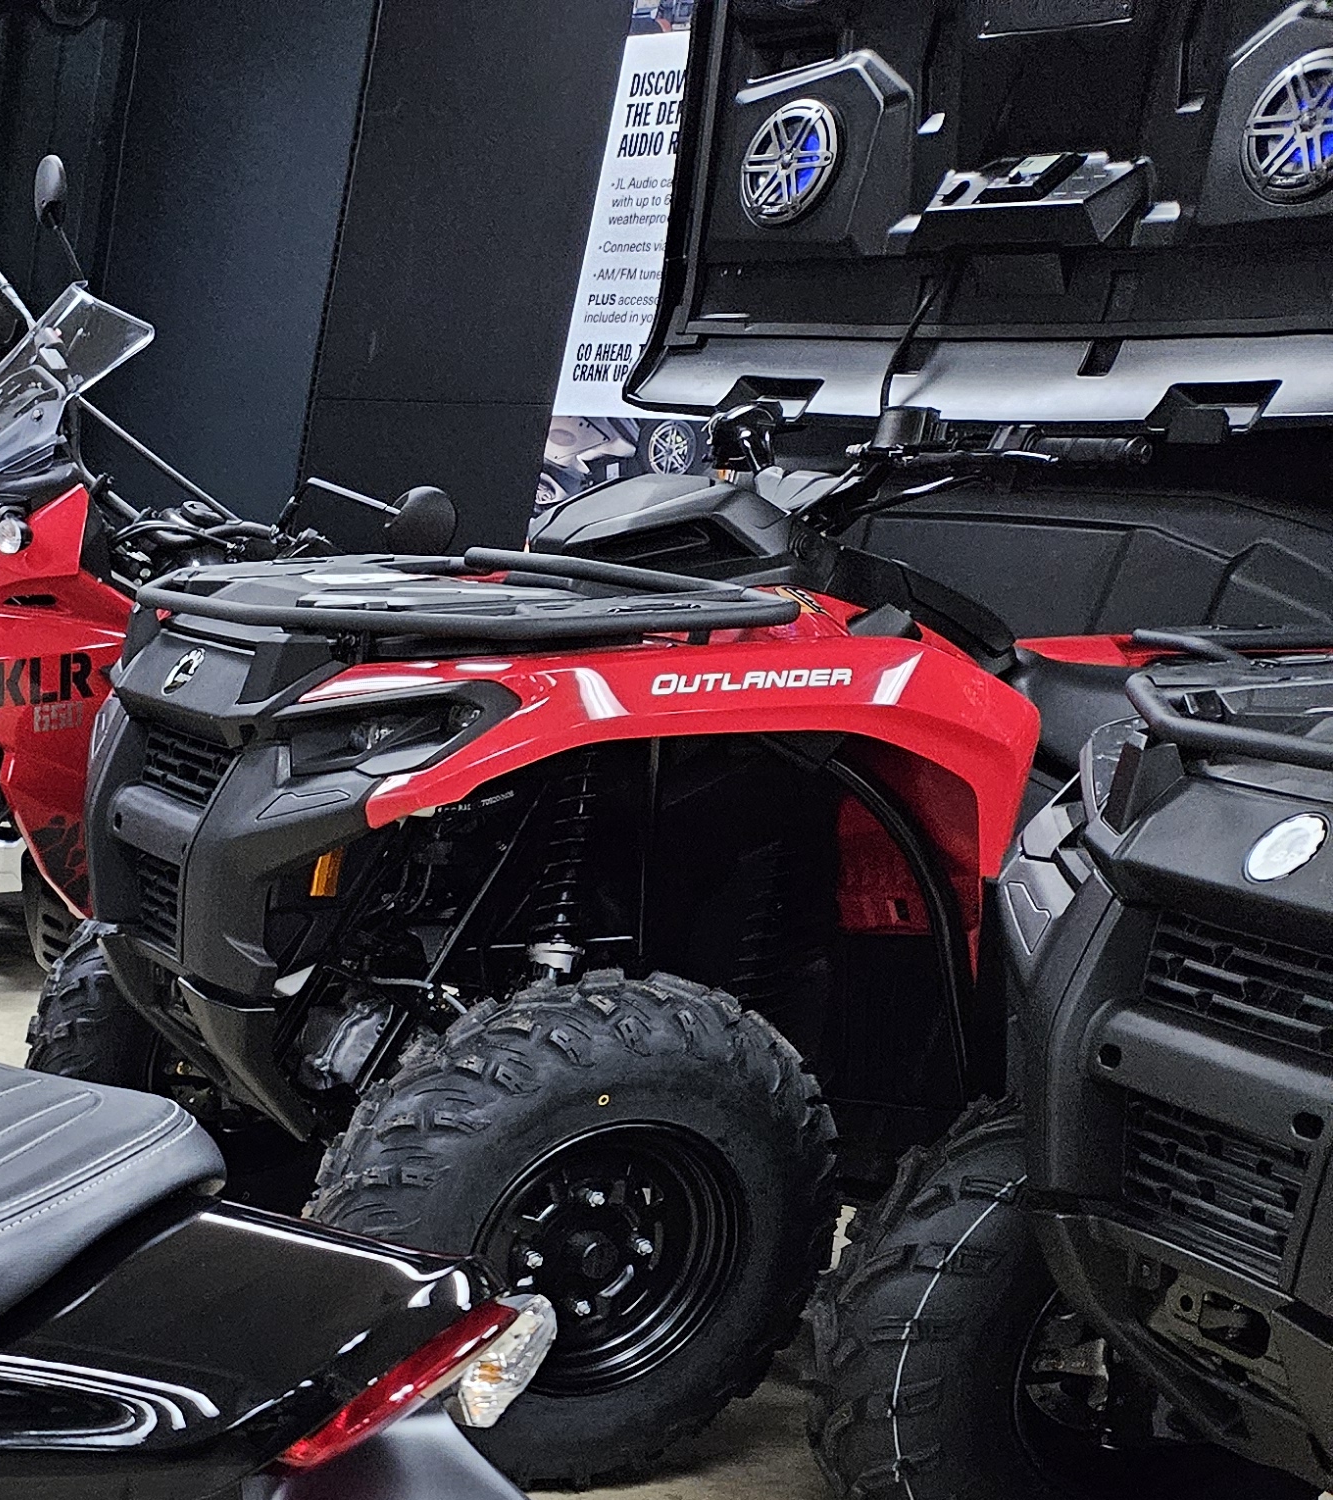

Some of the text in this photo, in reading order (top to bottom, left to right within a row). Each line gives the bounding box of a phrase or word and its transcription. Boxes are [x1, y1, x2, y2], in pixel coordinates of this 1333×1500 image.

[625, 102, 654, 128] THE
[617, 131, 664, 158] AUDIO
[615, 178, 625, 190] JL
[627, 177, 658, 189] Audio
[612, 195, 633, 207] with
[636, 197, 649, 209] up
[651, 195, 661, 206] to
[608, 213, 668, 228] weatherpro
[603, 240, 651, 253] Connects
[597, 268, 637, 281] AM/FM
[588, 294, 617, 306] PLUS
[584, 311, 627, 323] included
[629, 312, 639, 323] in
[577, 343, 592, 362] GO
[594, 343, 633, 364] AHEAD,
[573, 364, 611, 382] CRANK
[650, 667, 853, 696] OUTLANDER
[33, 701, 83, 733] 650
